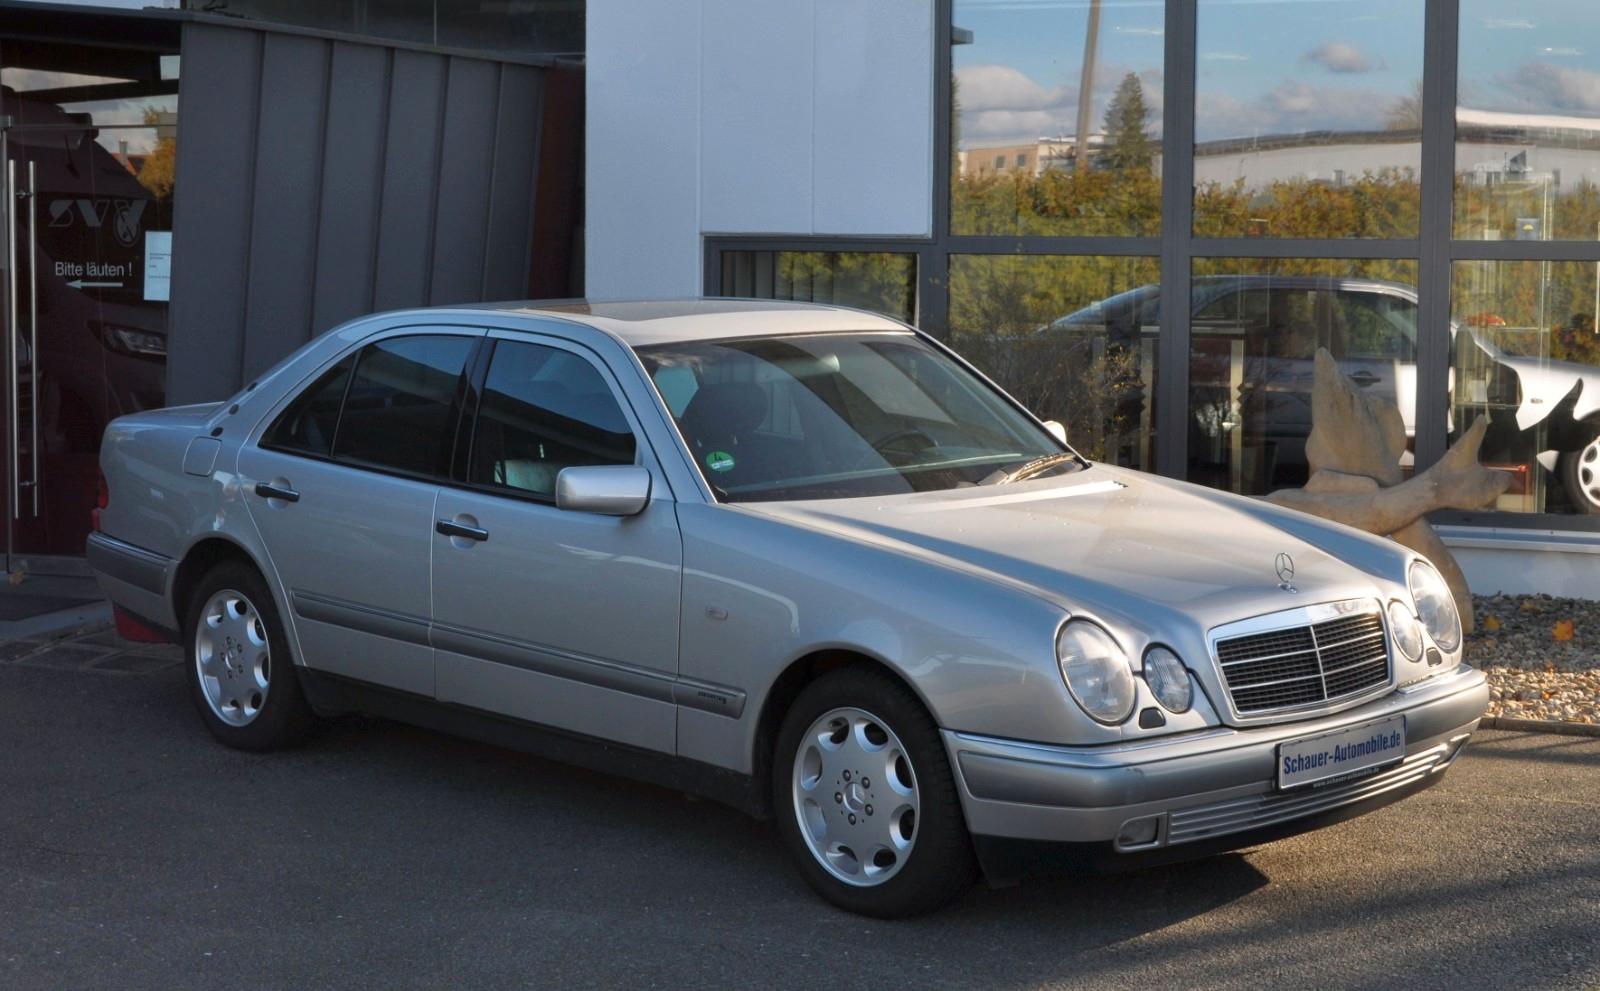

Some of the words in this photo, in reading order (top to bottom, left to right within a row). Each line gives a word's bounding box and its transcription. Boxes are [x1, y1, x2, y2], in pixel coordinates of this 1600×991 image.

[55, 261, 83, 276] Bitte
[86, 261, 125, 276] läuten
[1284, 730, 1400, 774] Schauer-Automobile.de
